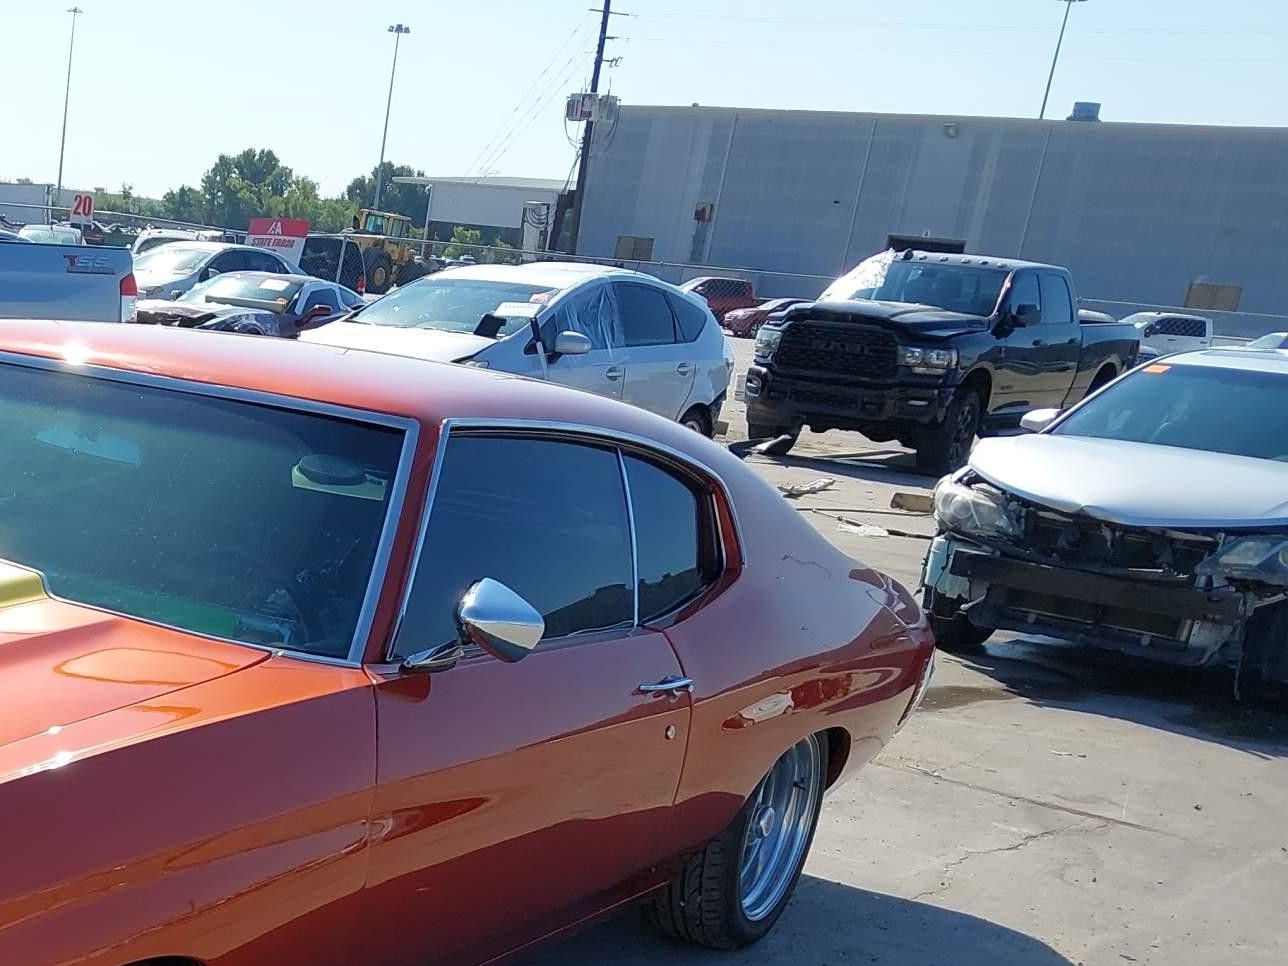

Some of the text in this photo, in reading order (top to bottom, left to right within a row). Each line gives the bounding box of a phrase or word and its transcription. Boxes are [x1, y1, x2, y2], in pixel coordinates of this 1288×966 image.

[73, 194, 92, 216] 20
[252, 237, 295, 248] STATE FARM
